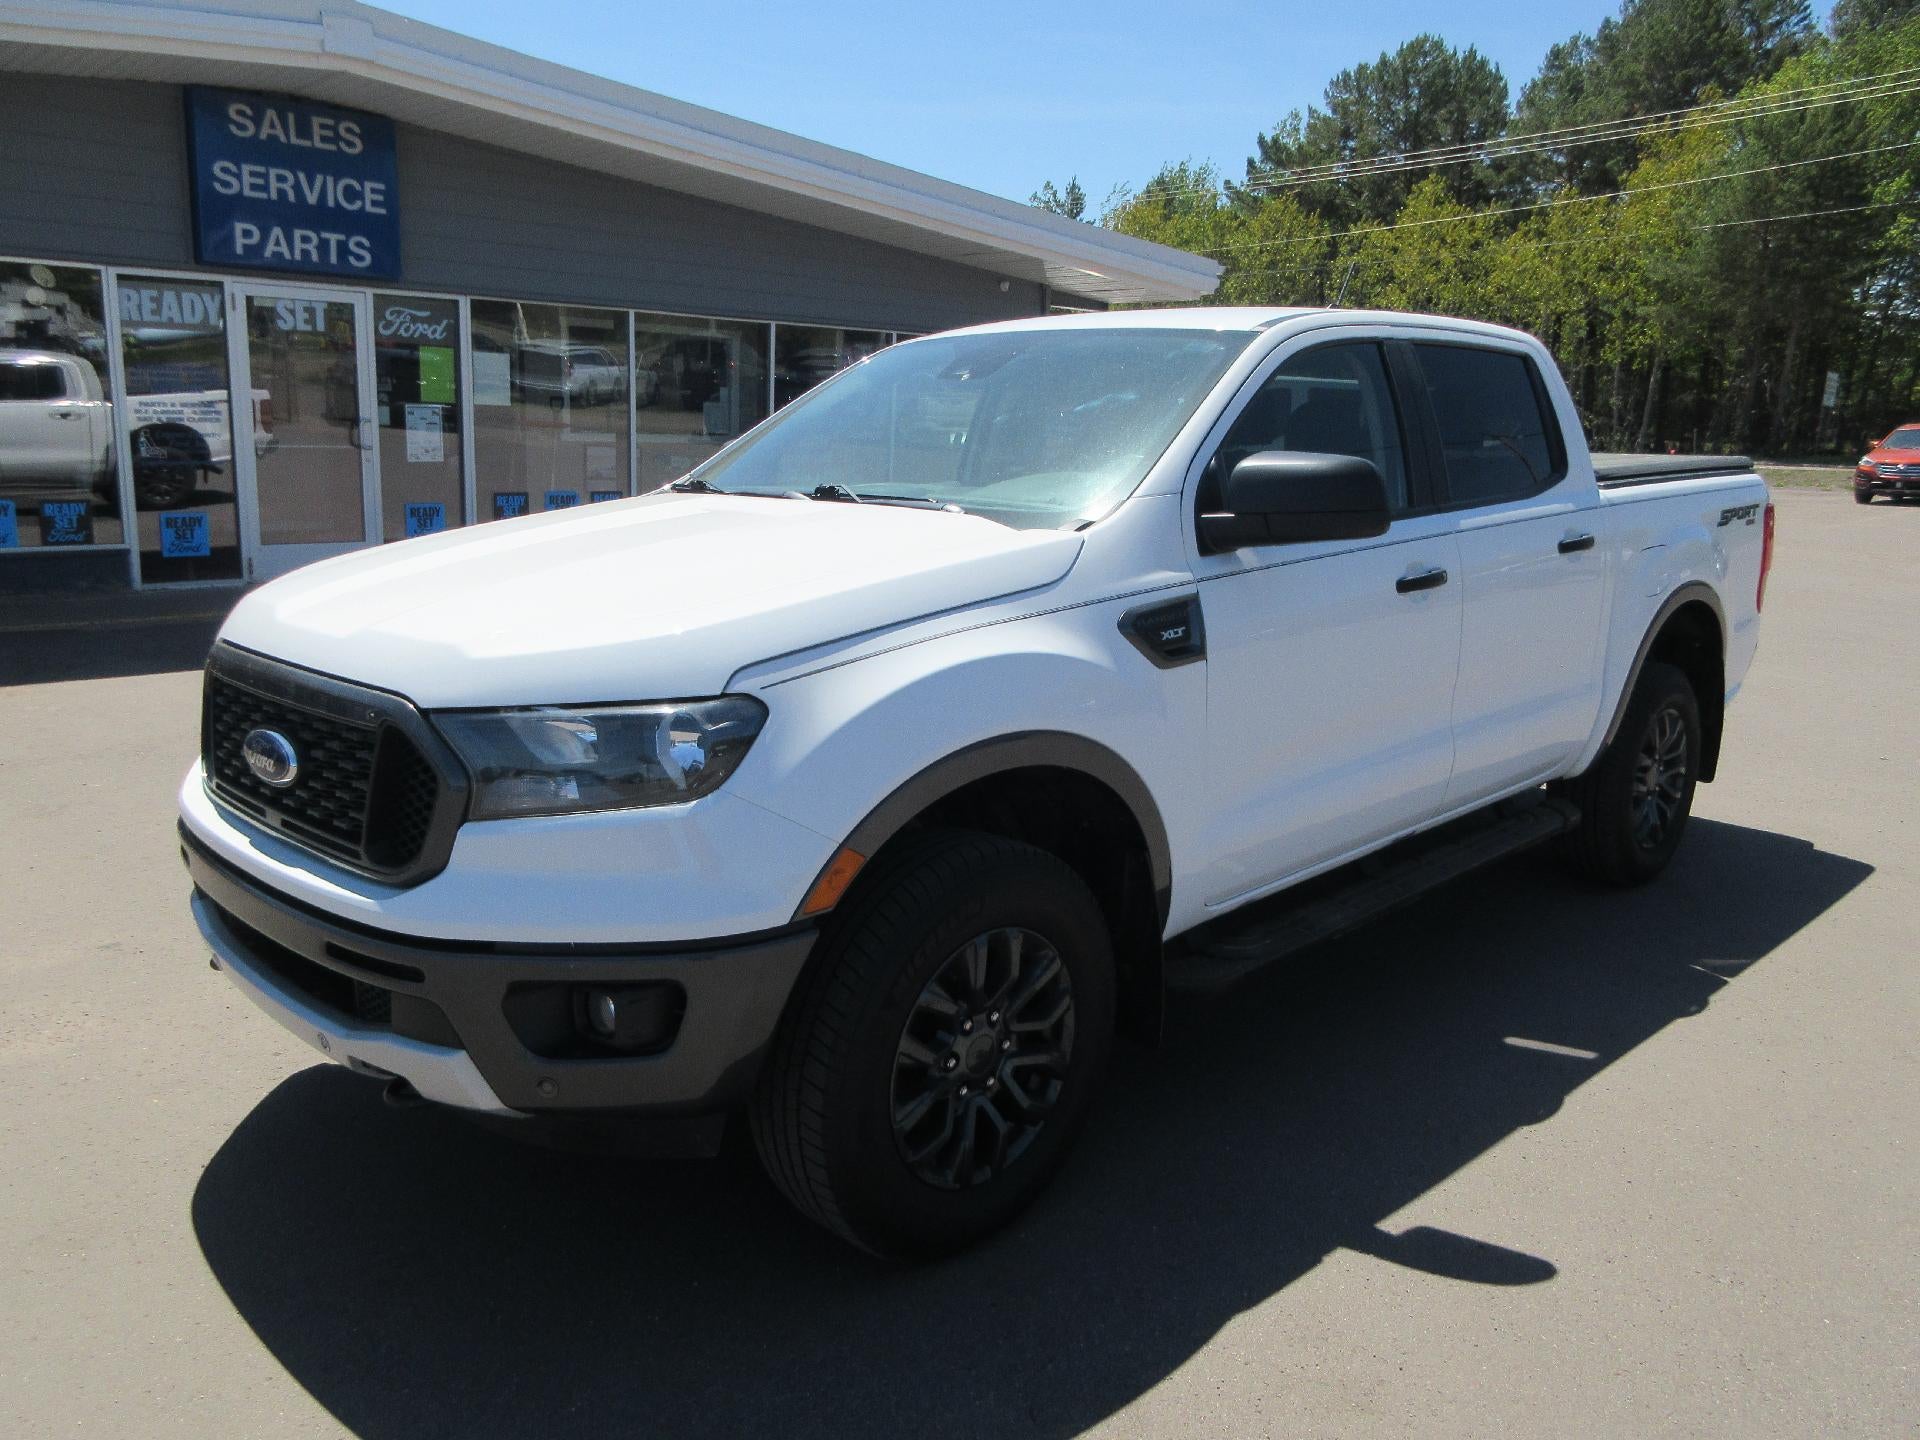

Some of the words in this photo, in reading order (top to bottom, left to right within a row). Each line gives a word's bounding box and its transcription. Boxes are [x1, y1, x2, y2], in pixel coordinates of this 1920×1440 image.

[227, 103, 364, 155] SALES
[212, 160, 387, 214] SERVICE
[233, 221, 373, 268] PARTS
[118, 287, 222, 326] READY
[275, 300, 328, 332] SET
[377, 306, 448, 341] Ford
[496, 495, 526, 506] READY
[549, 496, 577, 506] READY
[43, 503, 86, 515] READY
[411, 507, 441, 518] READY
[1717, 503, 1760, 527] SPORT
[54, 515, 78, 528] SET
[166, 516, 204, 529] READY
[416, 518, 434, 529] SET
[47, 529, 86, 542] Ford
[175, 527, 195, 540] SET
[168, 540, 203, 553] Ford
[1160, 626, 1186, 641] XLT
